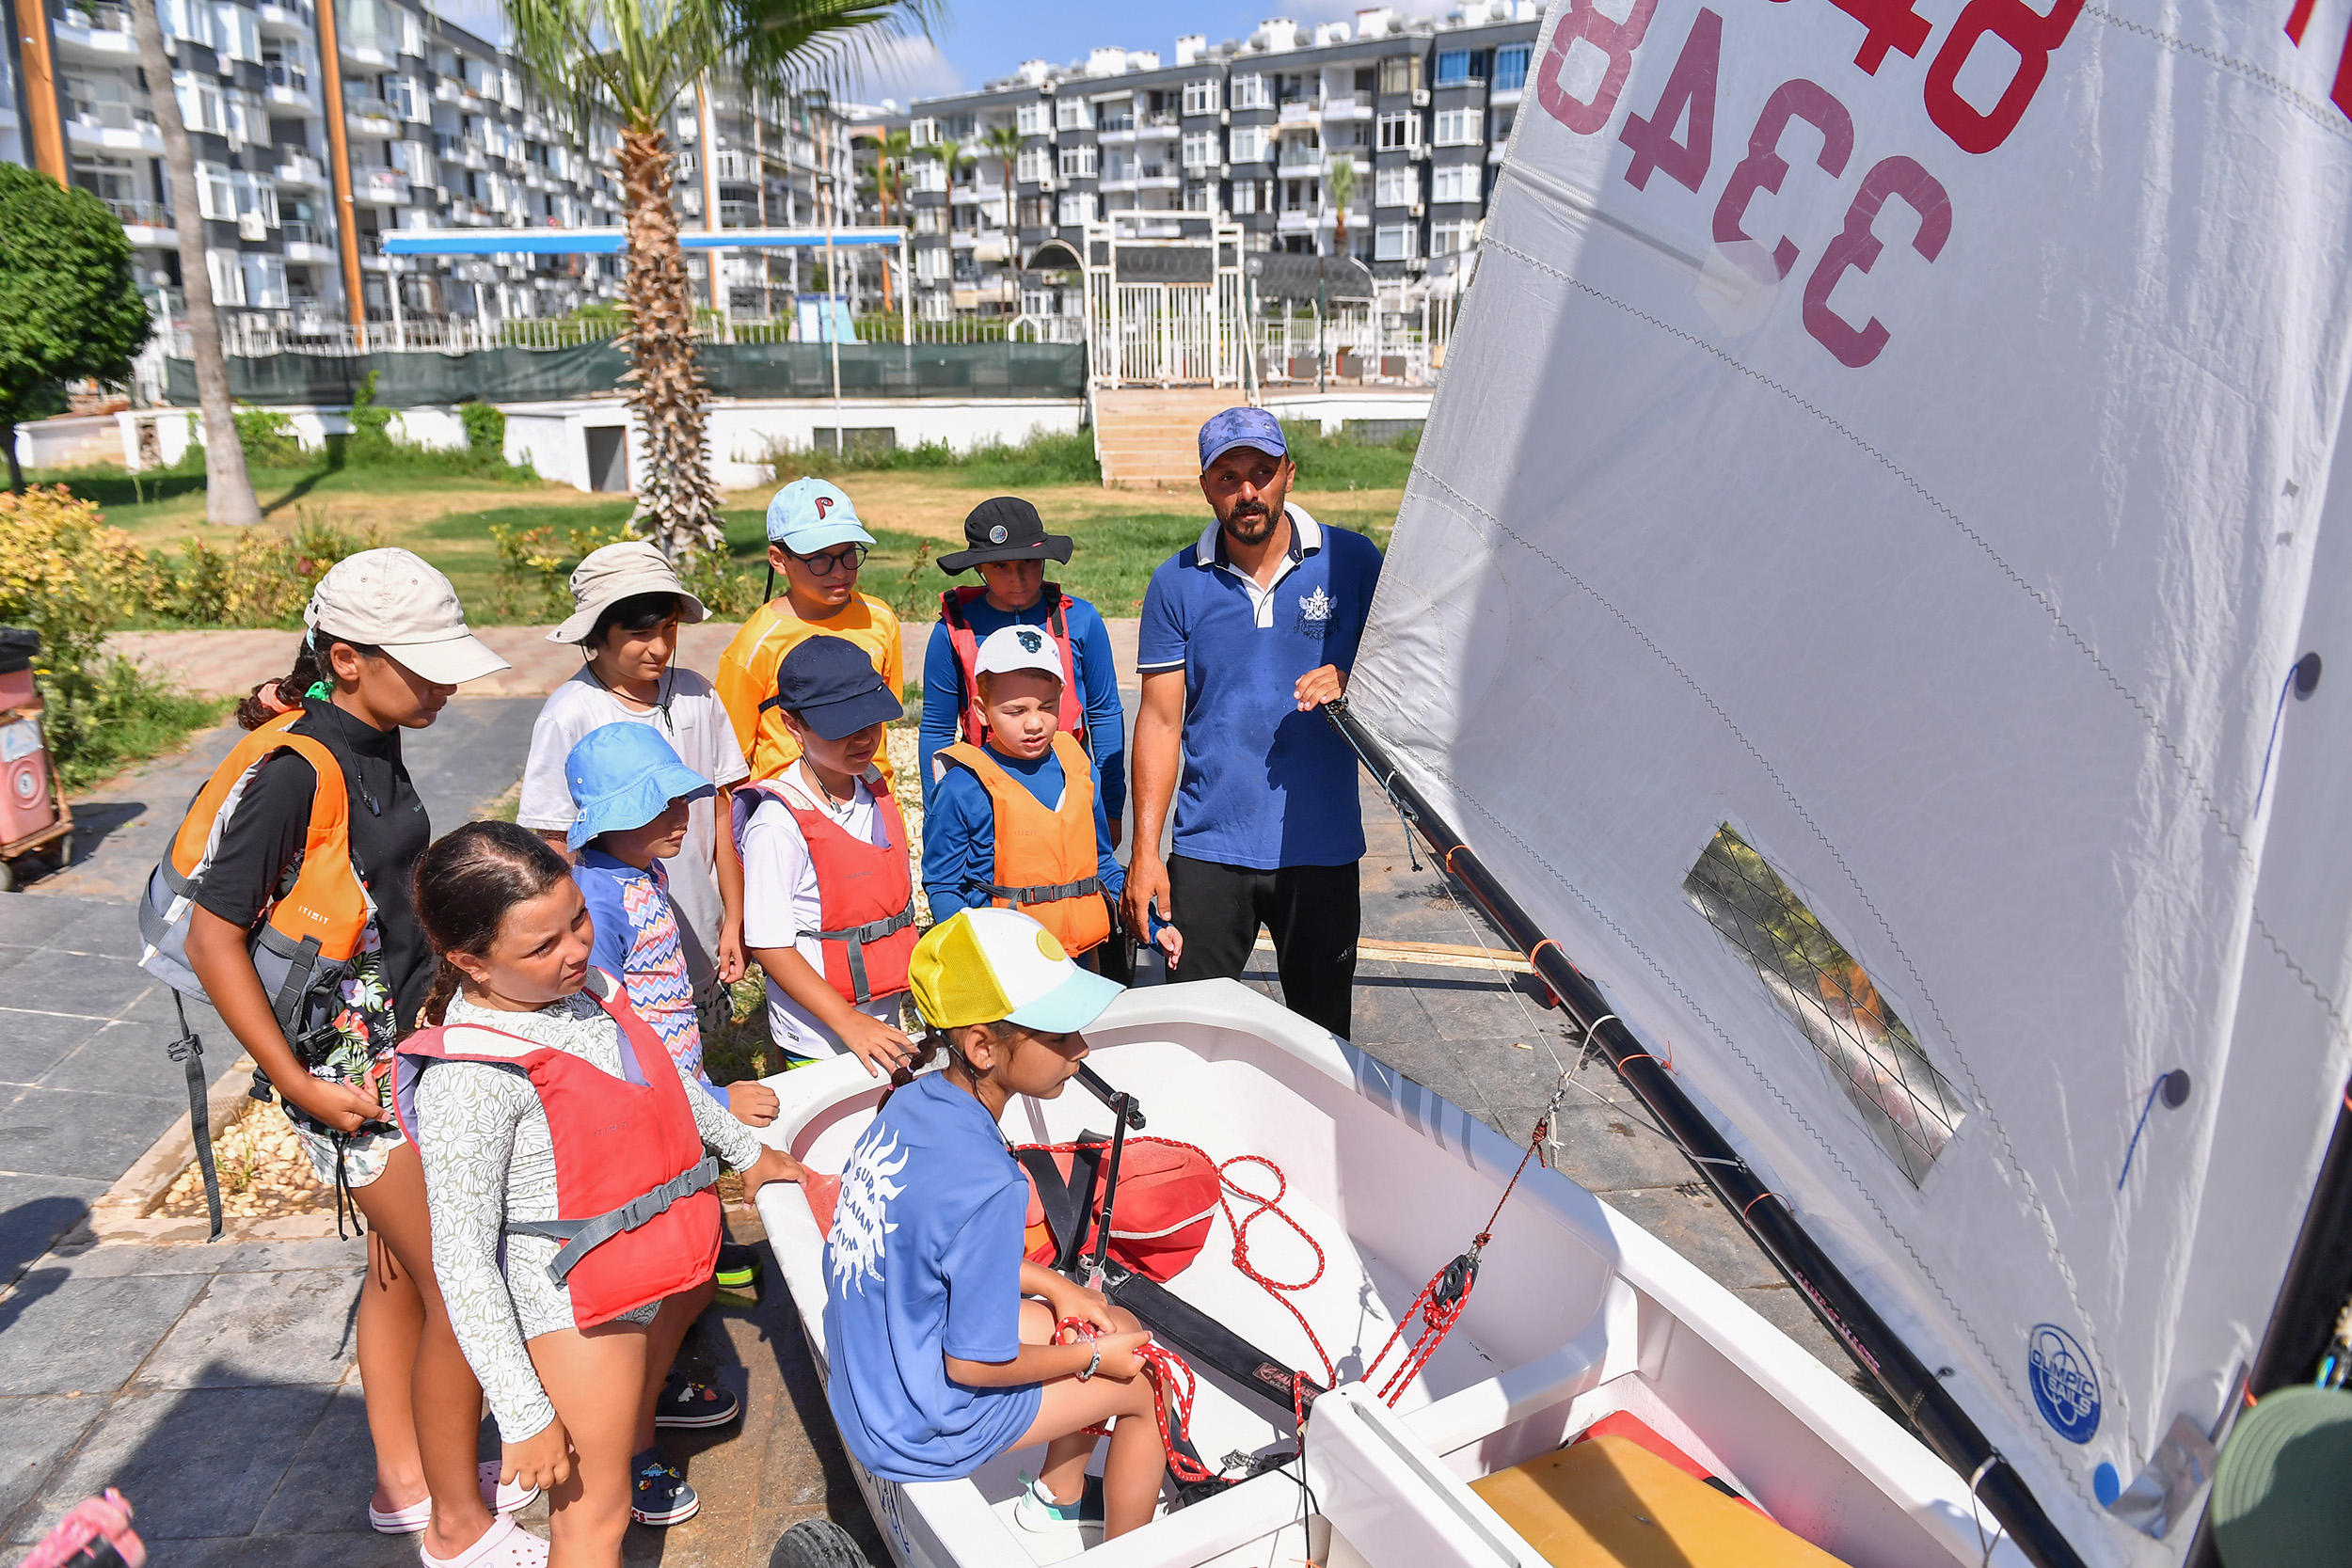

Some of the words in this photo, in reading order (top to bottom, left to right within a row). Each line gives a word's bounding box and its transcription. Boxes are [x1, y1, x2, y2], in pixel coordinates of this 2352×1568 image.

[815, 497, 834, 520] P
[298, 905, 329, 925] ITIWIT
[853, 1166, 876, 1205] SURF
[842, 1185, 874, 1235] OLAIAN
[835, 1227, 859, 1252] WAV
[2047, 1376, 2091, 1416] SAILS
